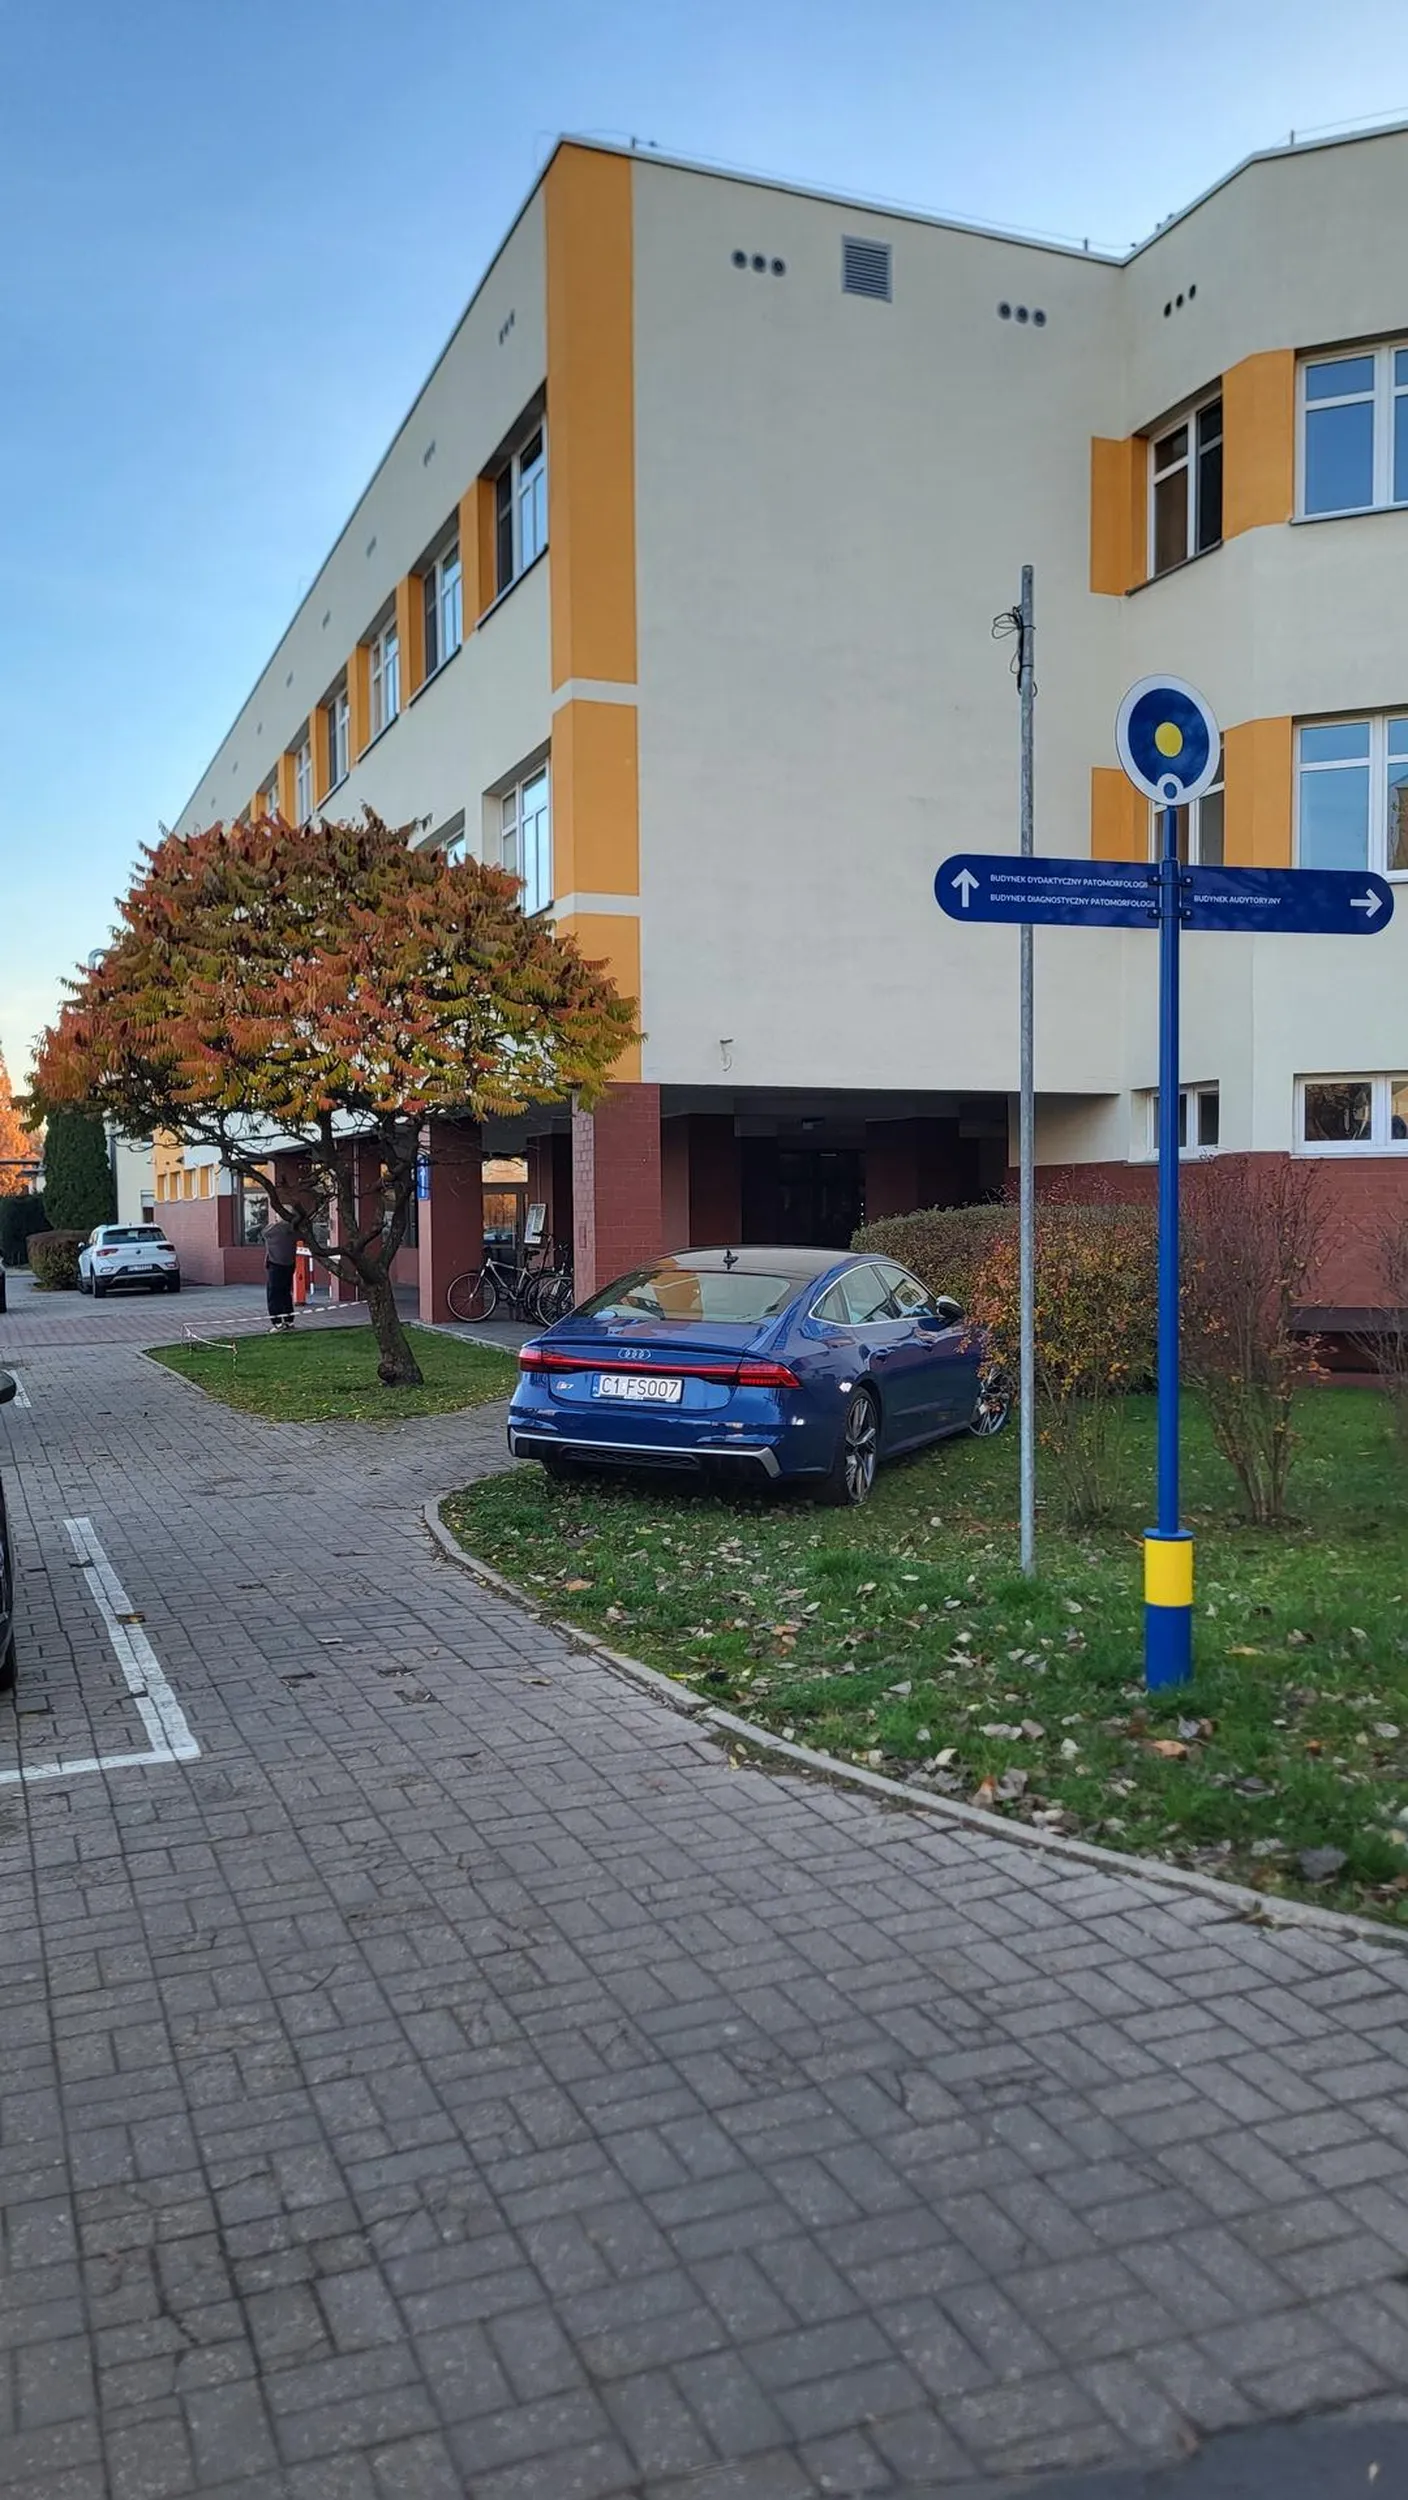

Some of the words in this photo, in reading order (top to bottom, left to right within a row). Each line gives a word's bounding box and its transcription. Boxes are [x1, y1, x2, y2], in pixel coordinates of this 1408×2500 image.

[990, 874, 1026, 883] BUDYNEK
[1027, 876, 1082, 886] DYDAKTYCZNY
[990, 894, 1026, 903] BUDYNEK
[1027, 895, 1089, 905] DIAGNOSTYCZNY
[1090, 898, 1156, 908] PATOMORFOLOGII
[1194, 894, 1229, 903] BUDYNEK
[1229, 896, 1281, 905] AUDYTORYJNY
[601, 1377, 620, 1394] C1
[626, 1378, 679, 1398] FS007
